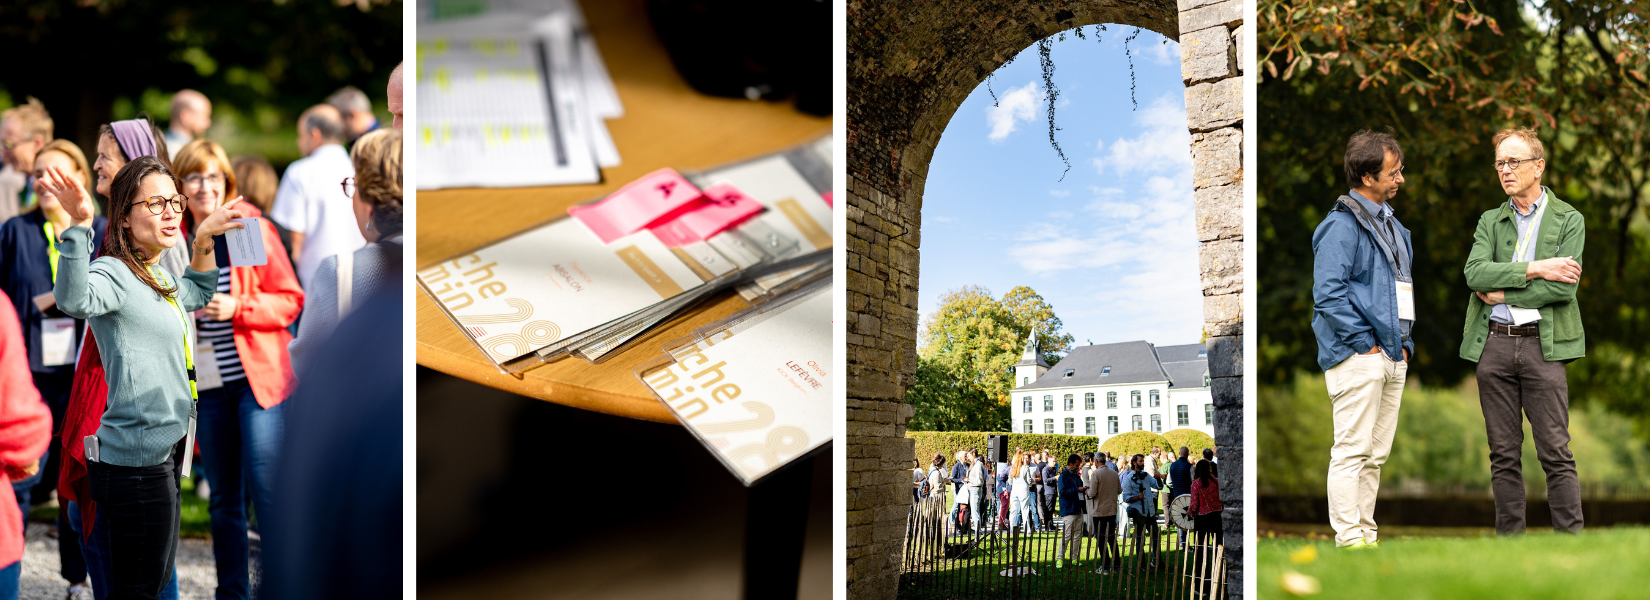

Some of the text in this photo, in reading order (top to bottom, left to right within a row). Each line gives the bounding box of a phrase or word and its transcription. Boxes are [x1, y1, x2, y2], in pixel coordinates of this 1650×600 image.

[552, 263, 585, 293] ABSALON
[785, 360, 823, 391] LEFÈVRE
[807, 360, 827, 377] Olivia
